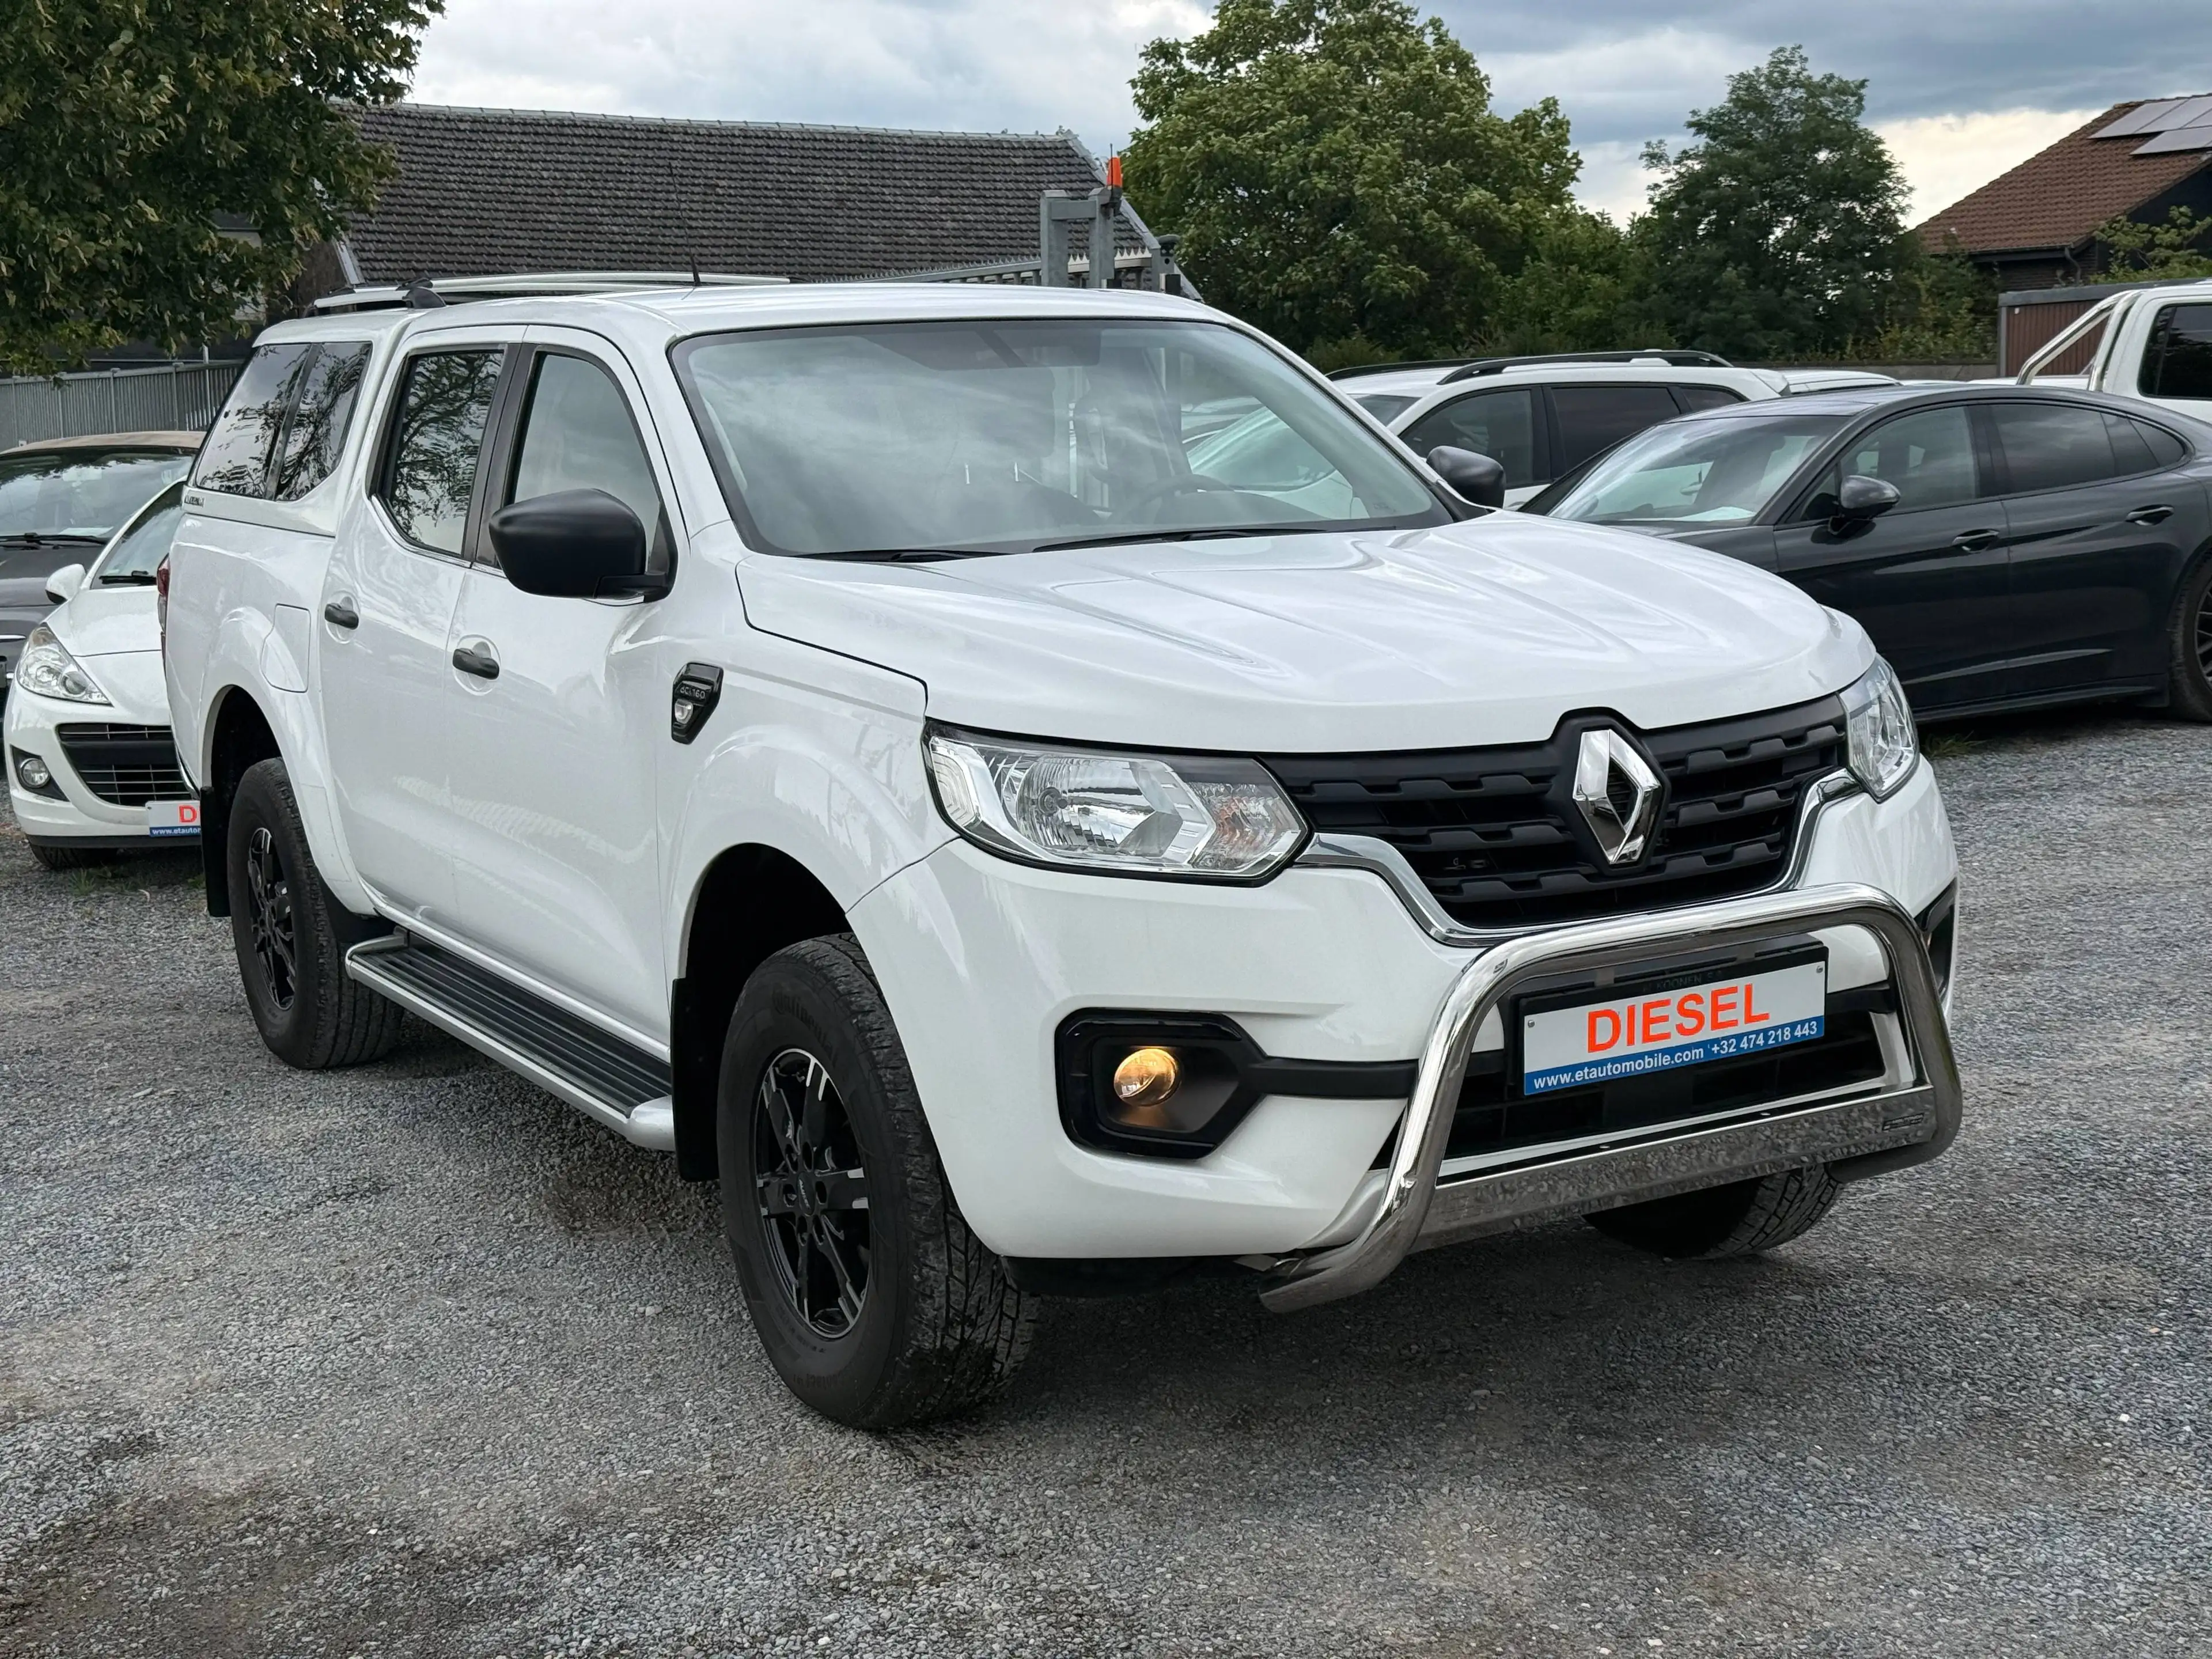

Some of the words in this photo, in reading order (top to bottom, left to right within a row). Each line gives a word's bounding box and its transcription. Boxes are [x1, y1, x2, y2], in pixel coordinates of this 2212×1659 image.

[692, 688, 706, 699] 160
[179, 805, 197, 823] D
[1588, 983, 1770, 1053] DIESEL
[1533, 1048, 1704, 1089] www.etautomobile.com
[1711, 1039, 1736, 1054] +32
[1740, 1033, 1764, 1050] 474
[1768, 1027, 1790, 1044] 218
[1794, 1021, 1817, 1037] 443
